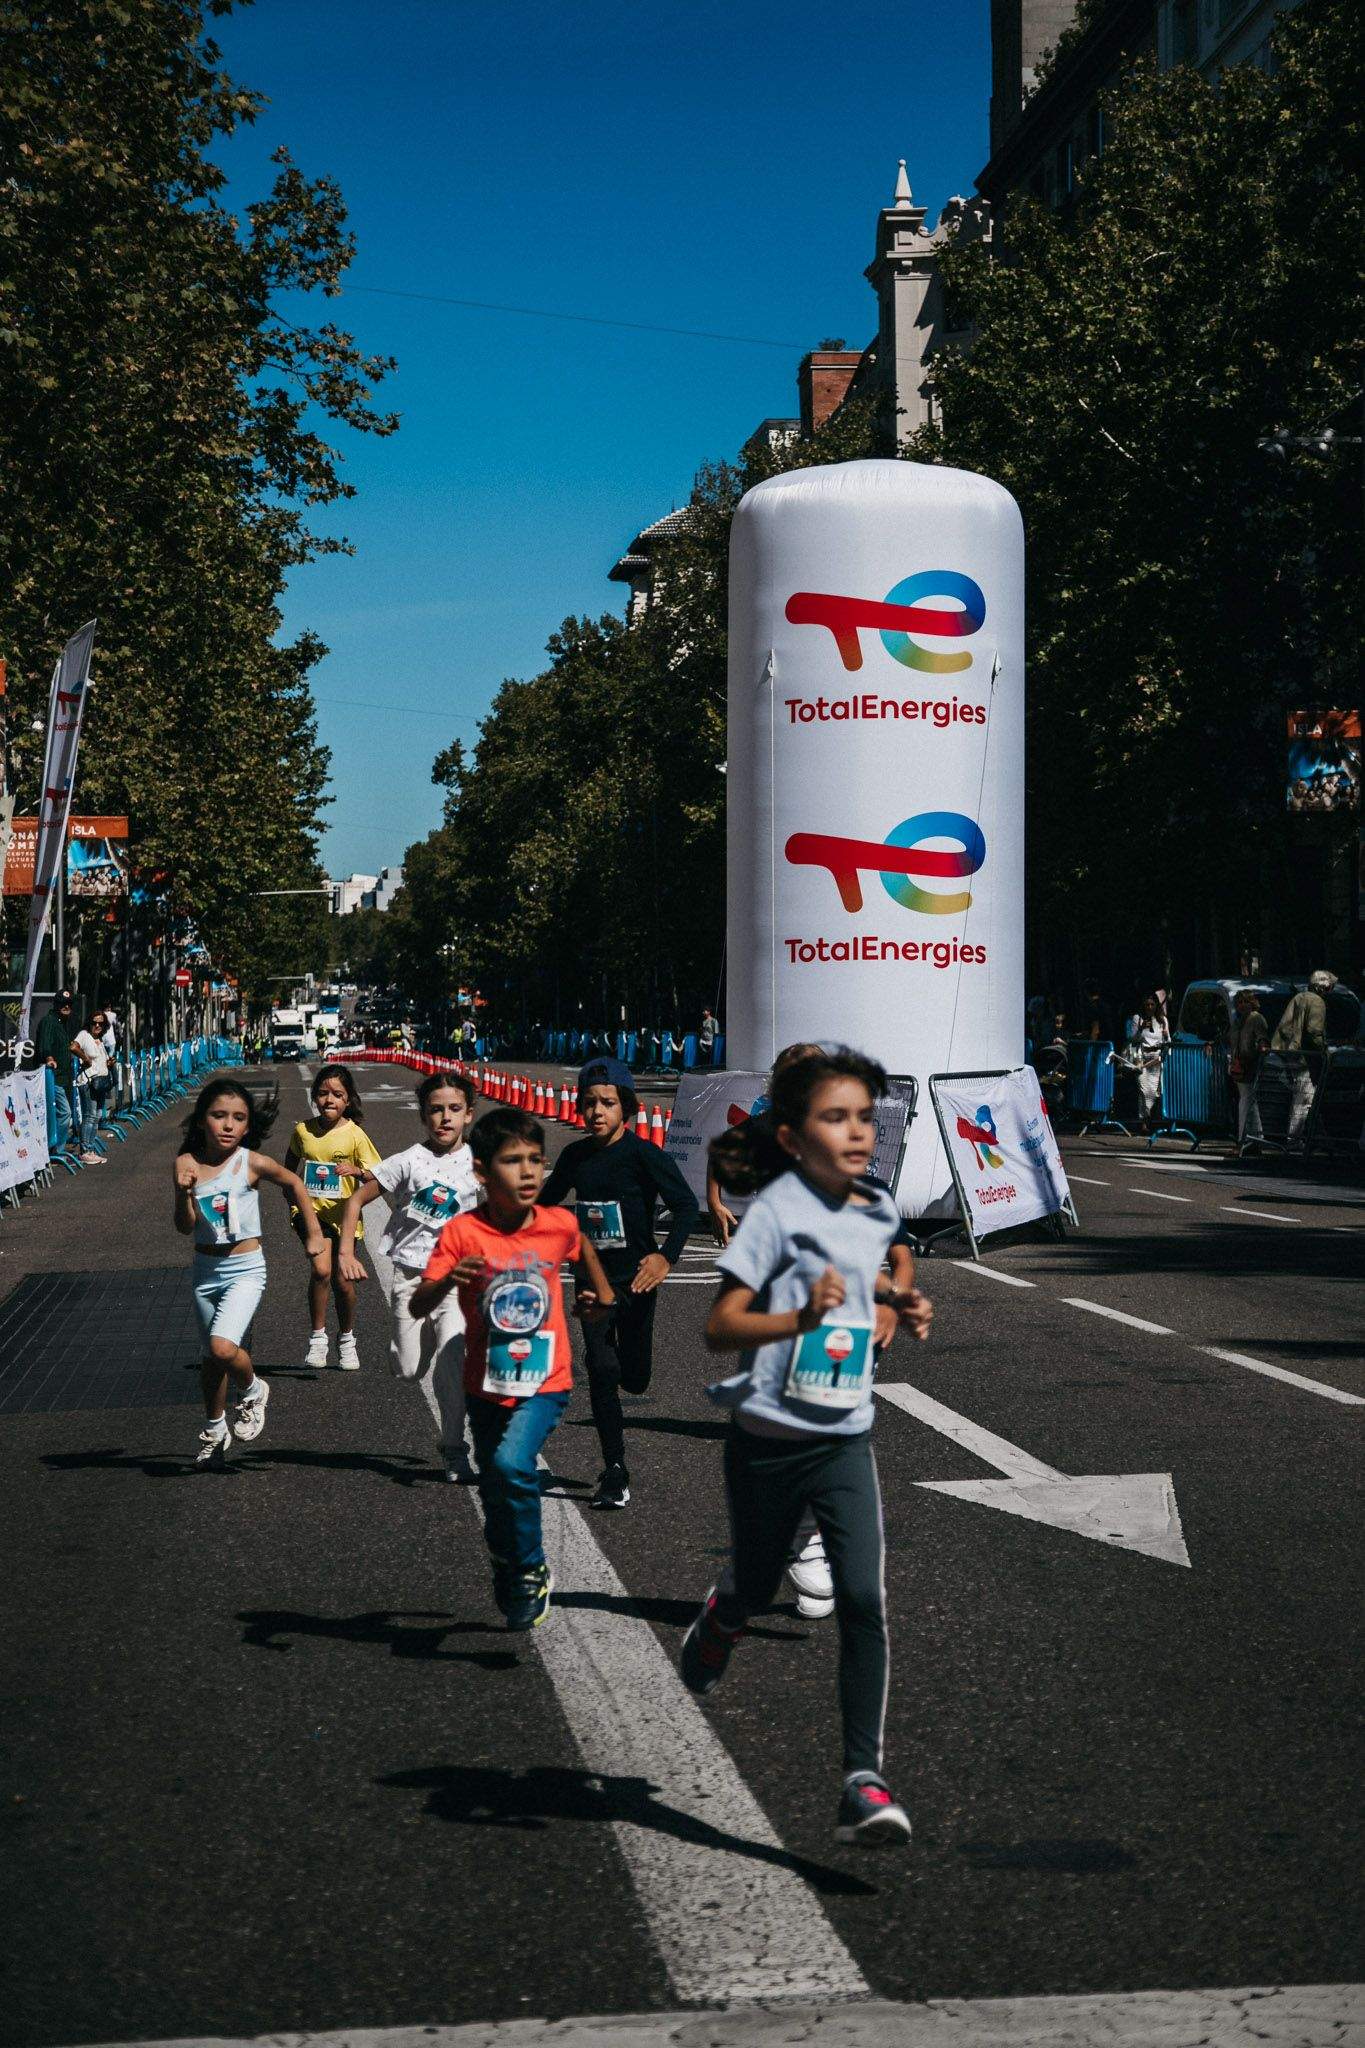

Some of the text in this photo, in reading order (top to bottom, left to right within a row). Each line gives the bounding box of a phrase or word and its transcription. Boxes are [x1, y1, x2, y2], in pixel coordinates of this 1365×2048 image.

[784, 694, 986, 728] TotalEnergies
[71, 825, 97, 835] ISLA
[7, 841, 35, 850] OME
[784, 936, 986, 969] TotalEnergies
[974, 1182, 1017, 1206] TotalEnergies
